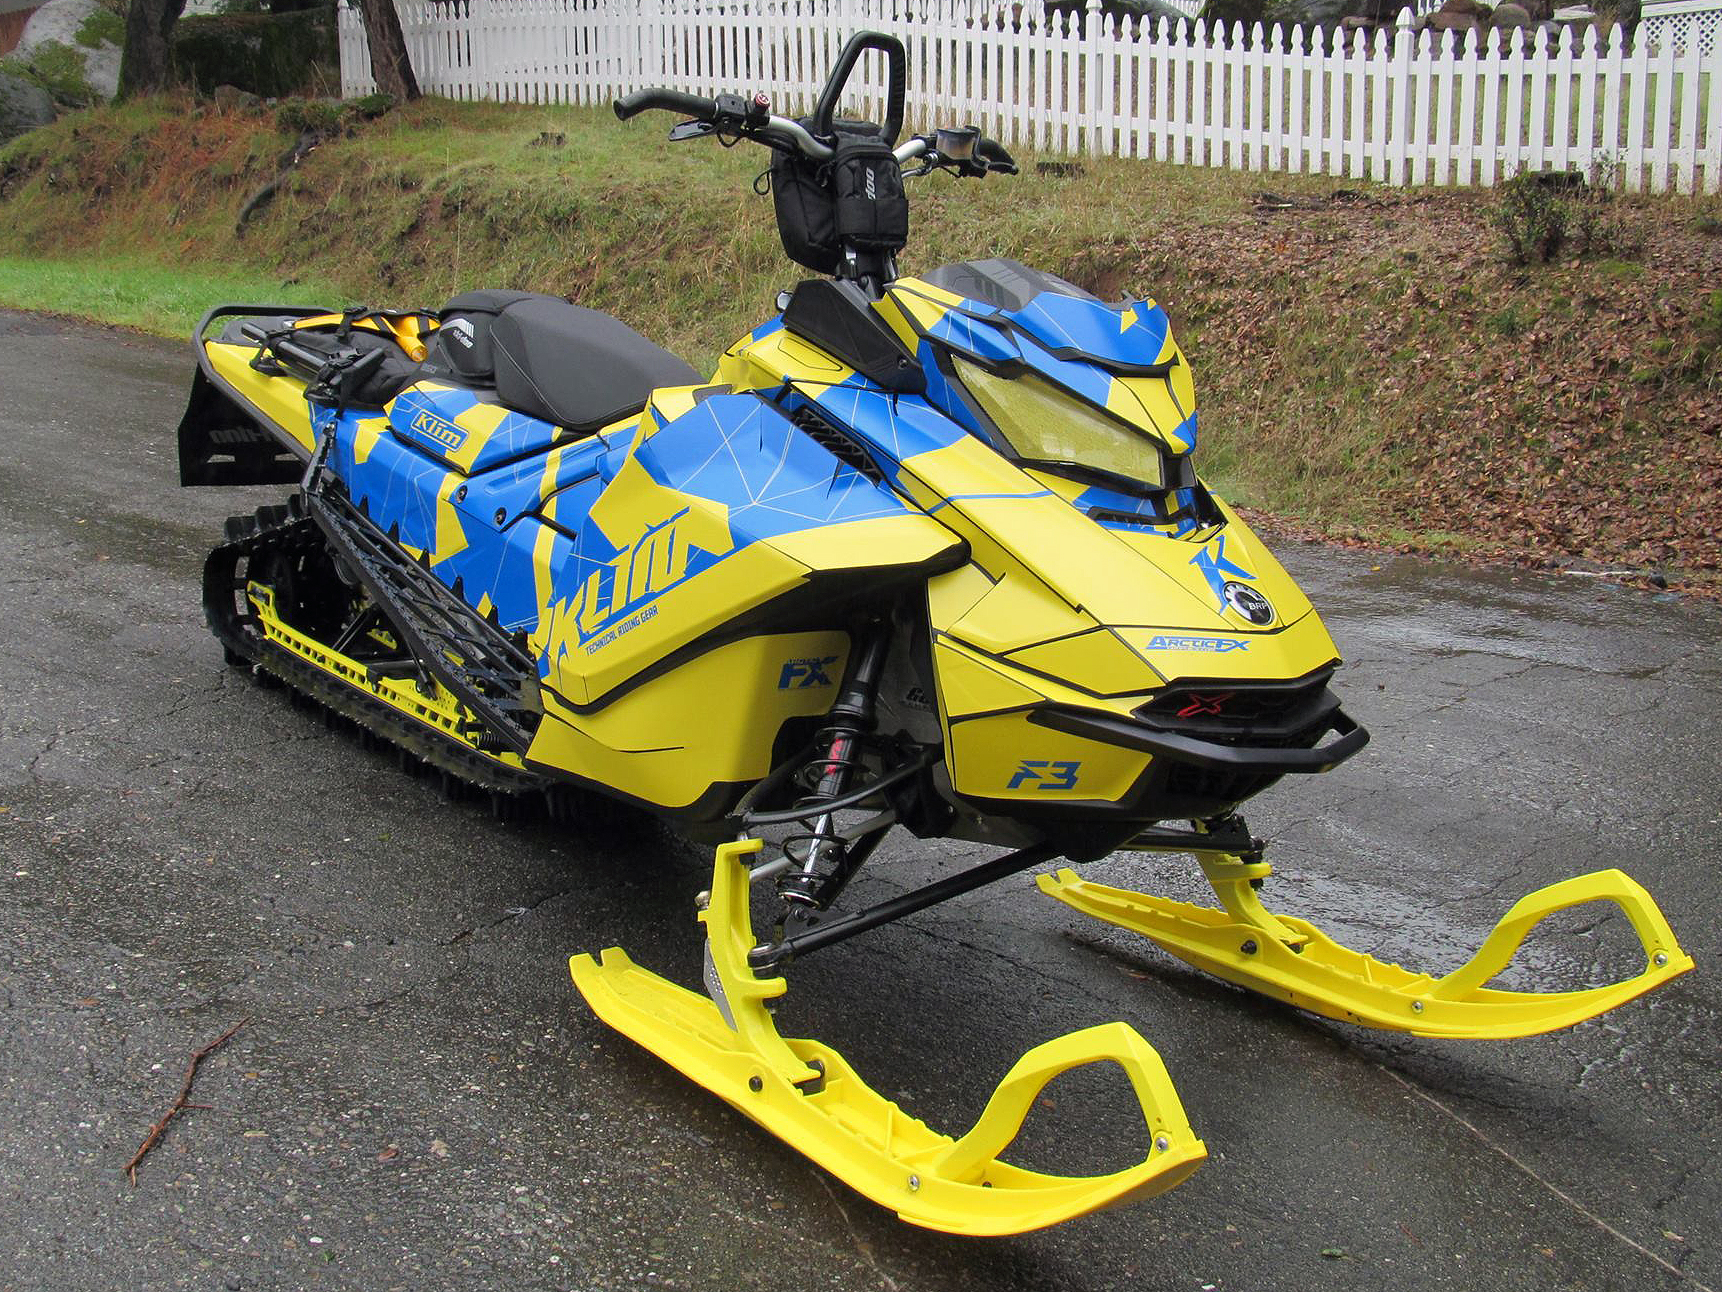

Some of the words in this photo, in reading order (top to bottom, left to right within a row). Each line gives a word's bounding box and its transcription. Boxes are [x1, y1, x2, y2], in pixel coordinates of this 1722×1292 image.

[1248, 602, 1269, 611] BRP
[586, 631, 617, 655] TECHNICAL
[618, 616, 641, 637] RIDING
[641, 605, 659, 623] GEAR
[778, 657, 838, 690] FX
[1006, 760, 1082, 790] F3
